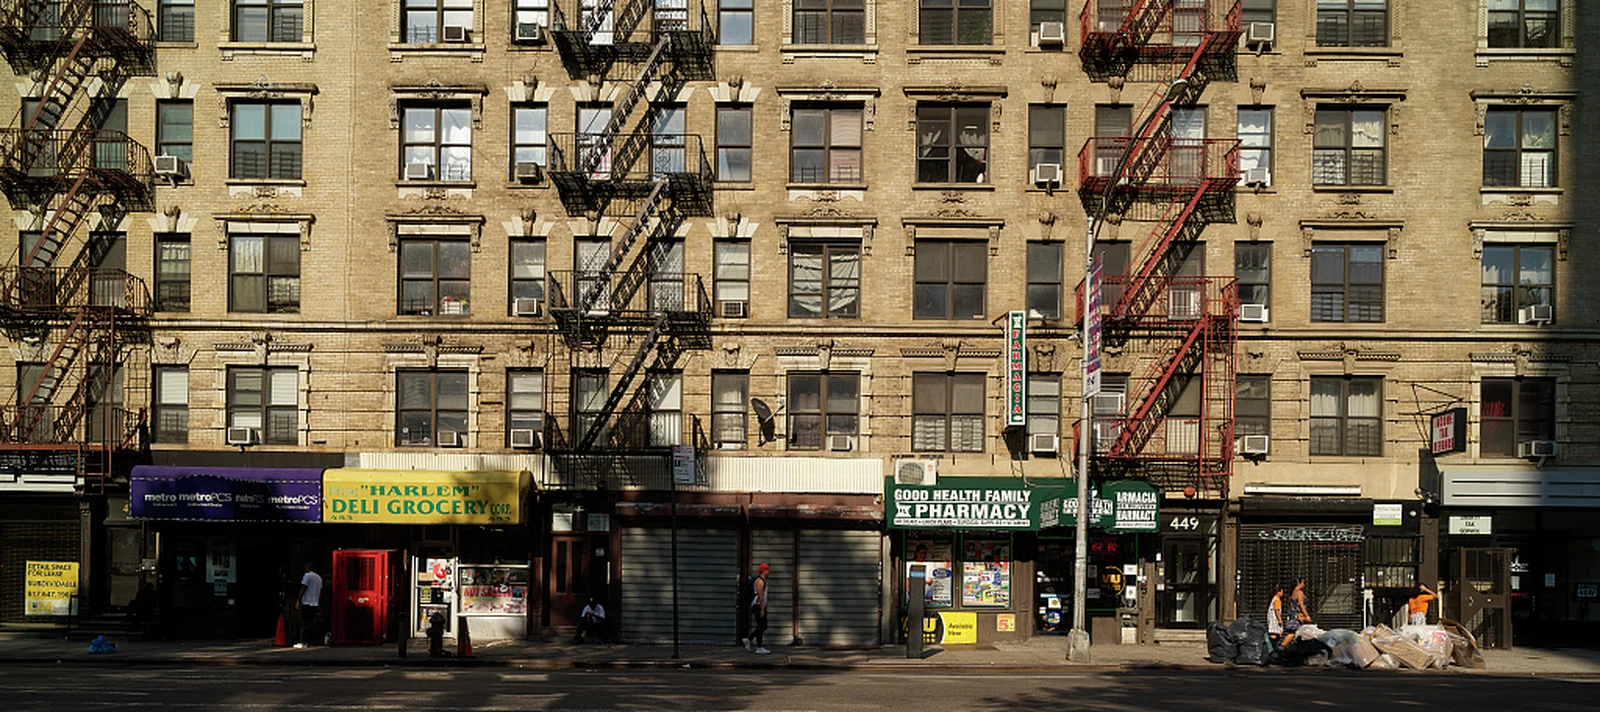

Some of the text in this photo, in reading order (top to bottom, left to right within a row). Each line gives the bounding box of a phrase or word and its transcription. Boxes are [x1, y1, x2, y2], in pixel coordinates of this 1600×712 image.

[1012, 330, 1022, 414] FARMACIA
[144, 492, 177, 503] metro
[178, 491, 231, 503] metroPCS
[268, 494, 317, 506] metroPCS
[894, 488, 1031, 503] GOOD HEALTH FAMILY
[1115, 491, 1156, 504] ARMACIA
[332, 499, 378, 514] DELI
[387, 499, 488, 515] GROCERY
[914, 502, 1031, 519] PHARMACY
[1169, 516, 1200, 531] 449
